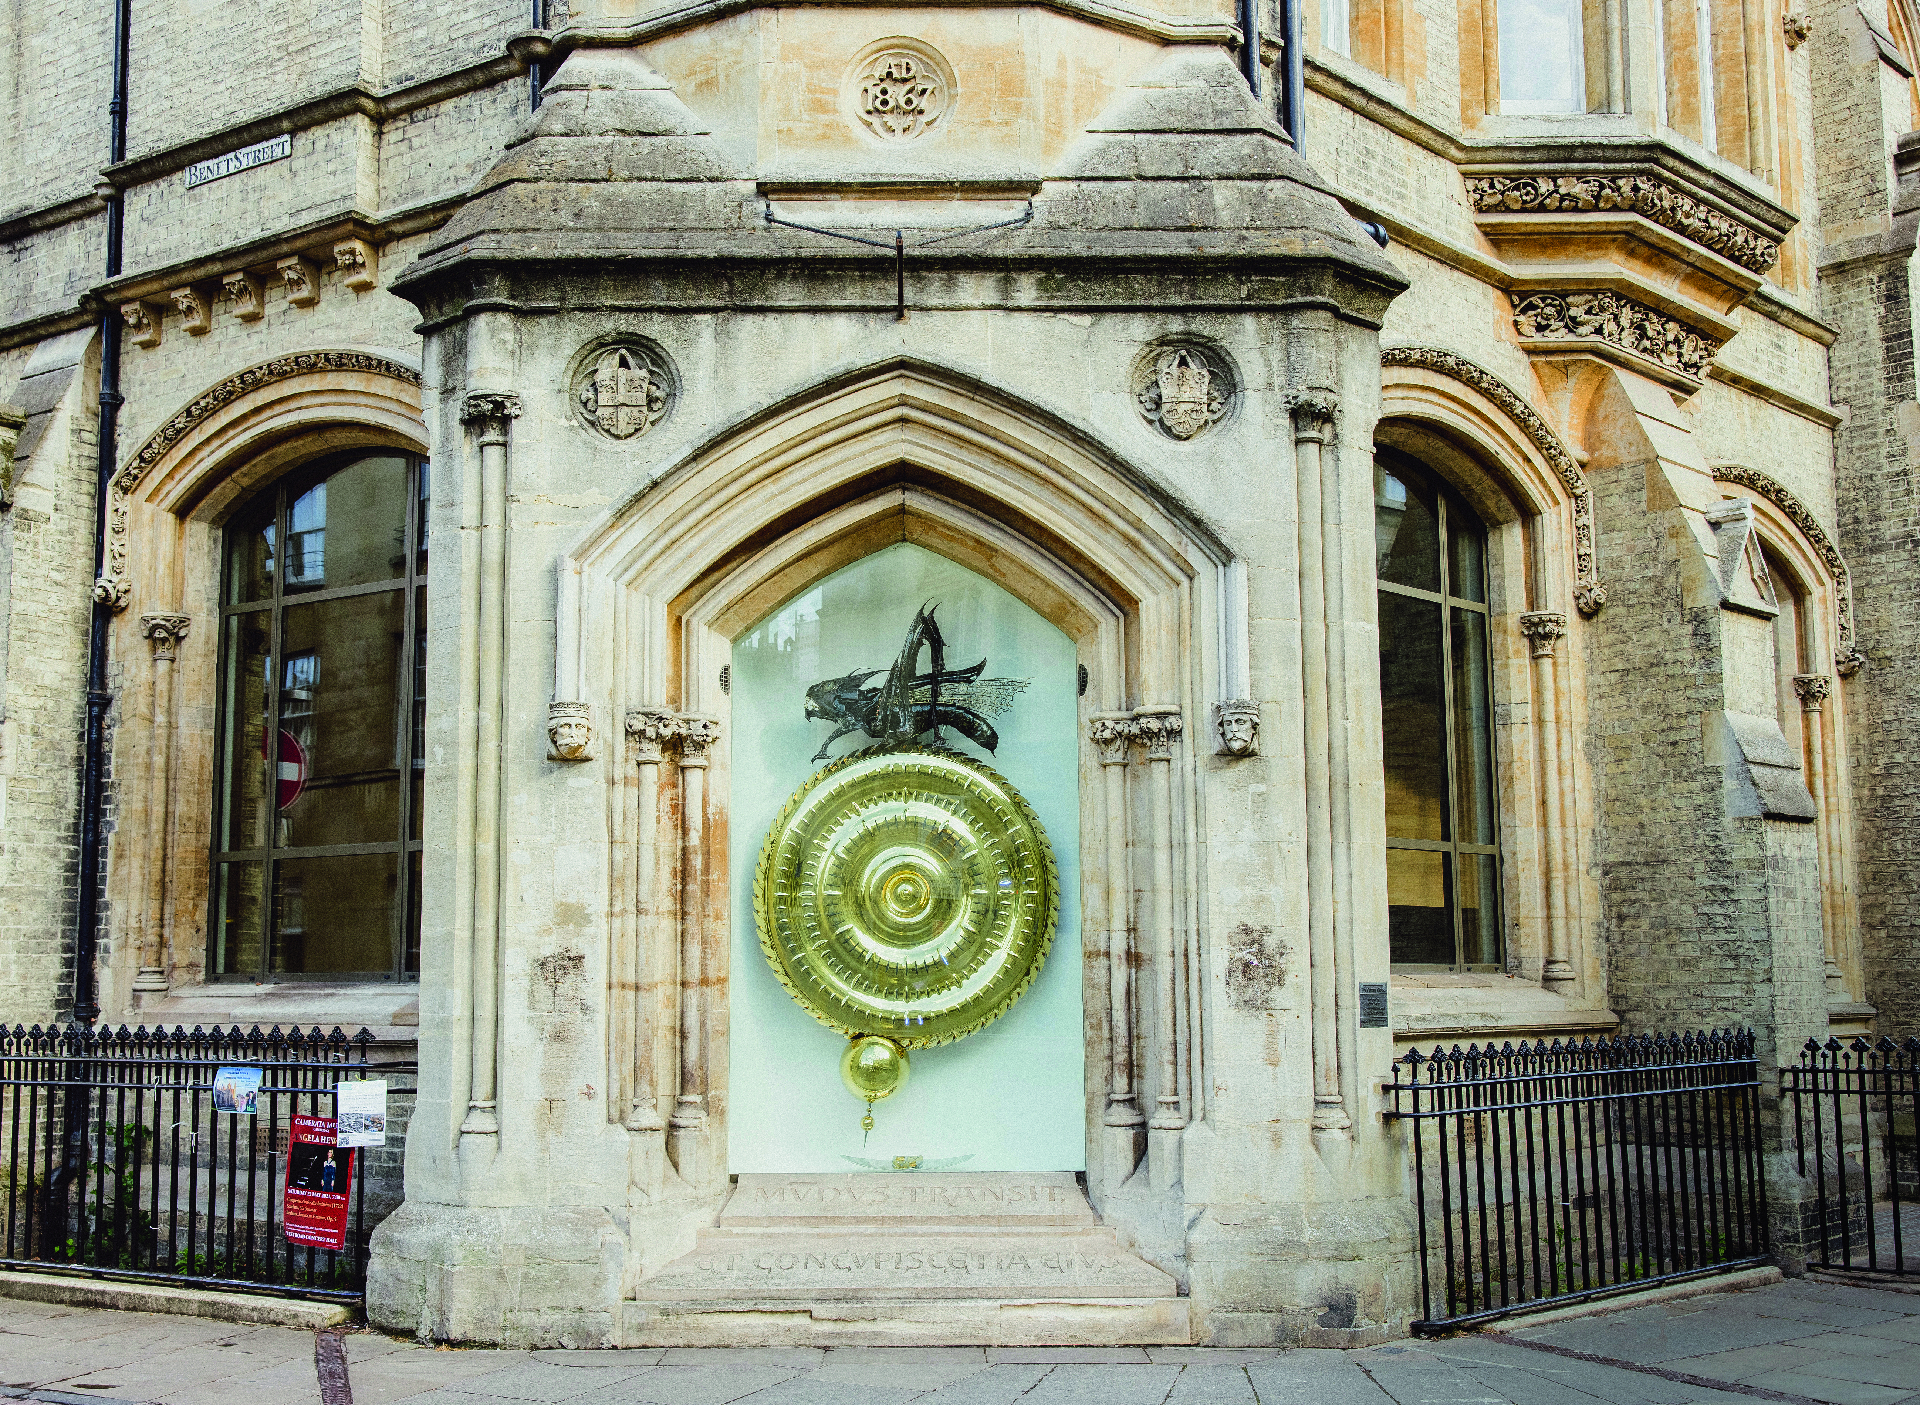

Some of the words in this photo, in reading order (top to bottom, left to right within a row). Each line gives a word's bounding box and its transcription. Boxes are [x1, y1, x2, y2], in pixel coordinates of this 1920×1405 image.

[862, 83, 936, 113] 1867
[233, 139, 288, 170] STREET
[320, 1135, 338, 1145] HEW
